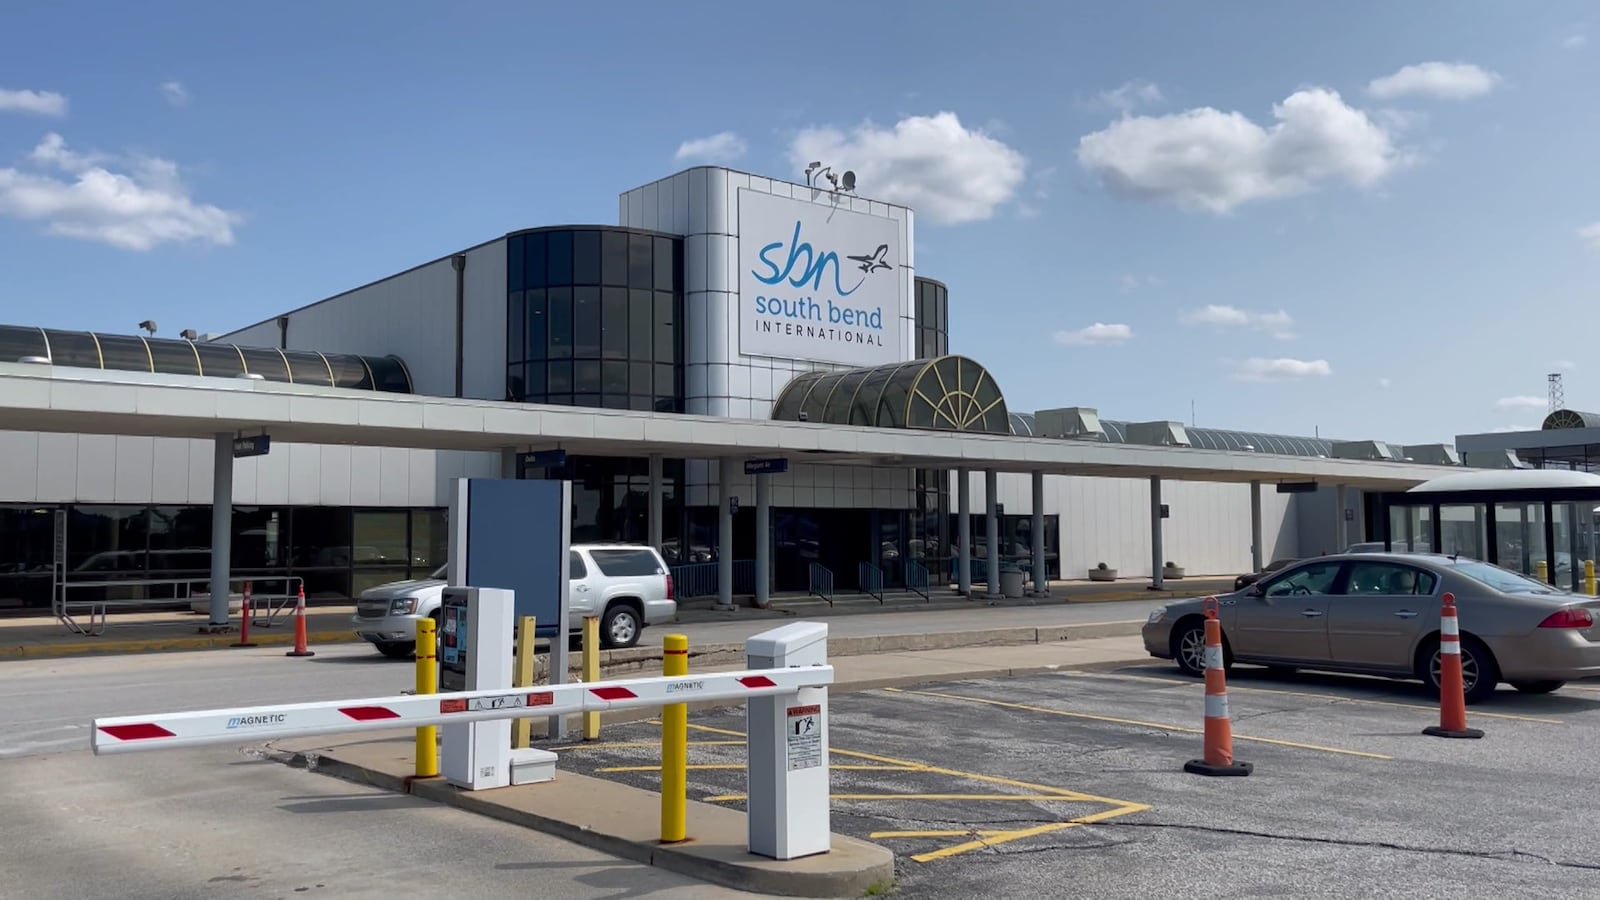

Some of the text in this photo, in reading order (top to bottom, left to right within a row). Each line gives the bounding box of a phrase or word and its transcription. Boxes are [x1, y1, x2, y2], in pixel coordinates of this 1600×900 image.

[752, 220, 865, 296] sbn
[755, 295, 883, 330] south bend
[755, 319, 883, 347] INTERNATIONAL
